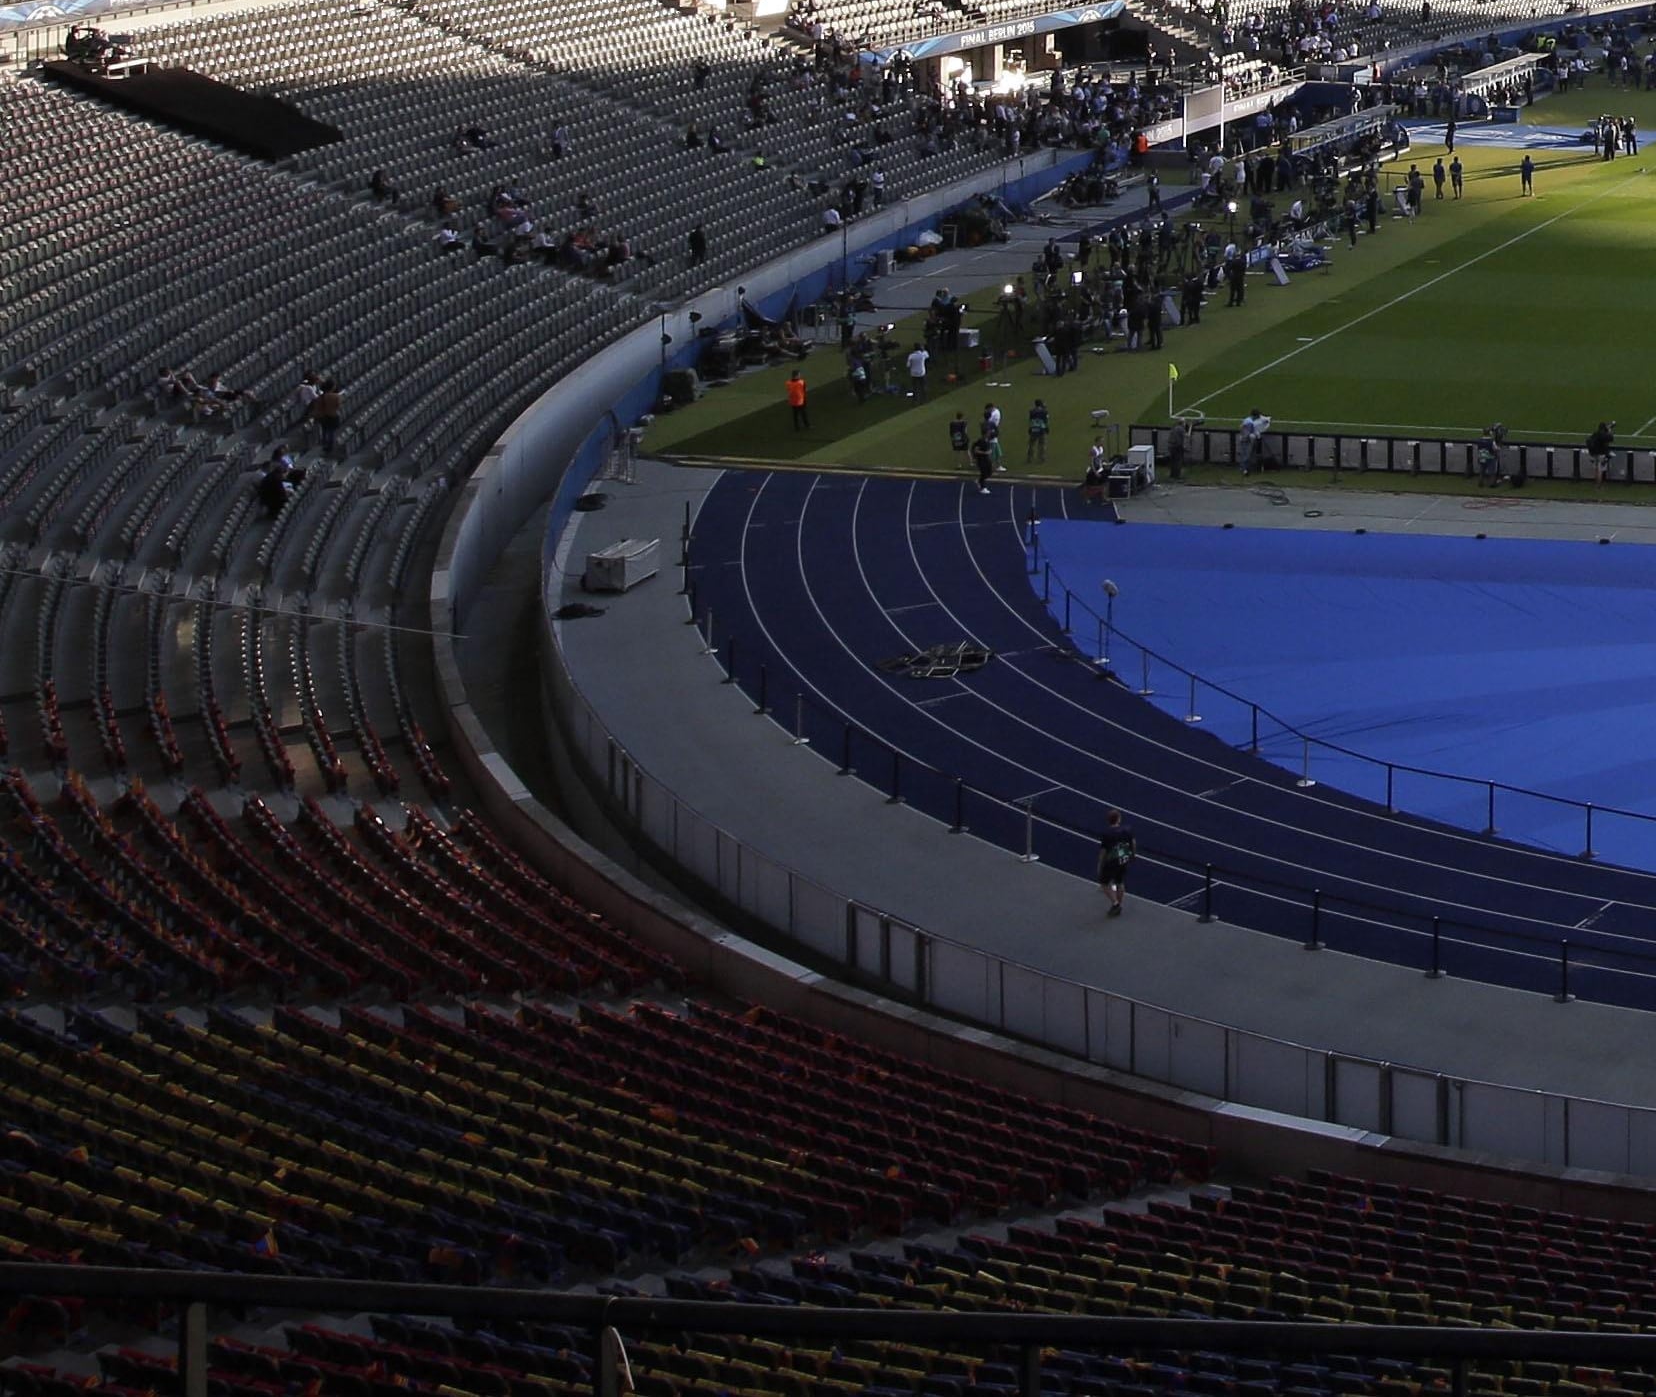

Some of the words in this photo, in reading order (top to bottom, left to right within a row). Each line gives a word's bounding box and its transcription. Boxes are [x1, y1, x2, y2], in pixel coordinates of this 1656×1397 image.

[961, 31, 986, 46] FINAL
[988, 24, 1015, 42] BERLIN
[1016, 21, 1035, 37] 2015
